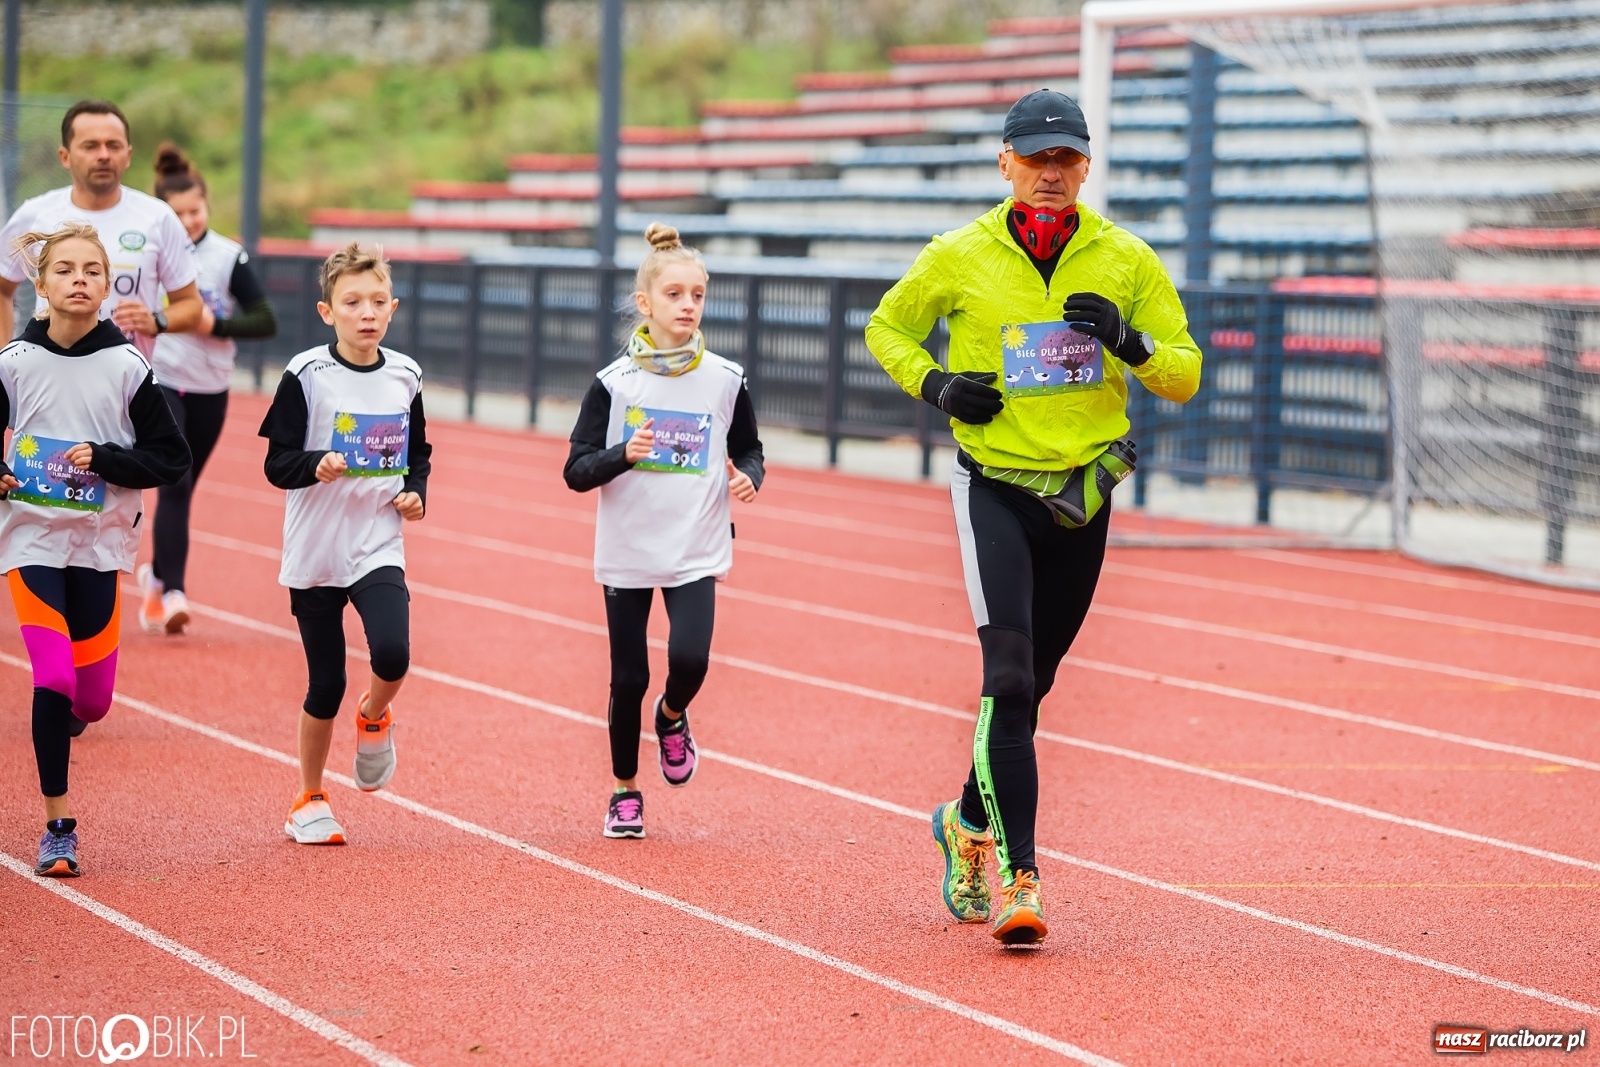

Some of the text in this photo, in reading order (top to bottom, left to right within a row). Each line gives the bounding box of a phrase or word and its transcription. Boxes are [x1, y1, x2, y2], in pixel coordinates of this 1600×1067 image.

[1016, 349, 1036, 359] BIEG
[1041, 347, 1058, 357] DLA
[1063, 367, 1094, 383] 229
[344, 434, 362, 444] BIEG
[366, 436, 380, 445] DLA
[655, 430, 671, 440] DLA
[26, 459, 99, 477] BIEG DLA BOE
[379, 453, 402, 469] 056
[671, 452, 700, 468] 096
[64, 486, 95, 502] 026
